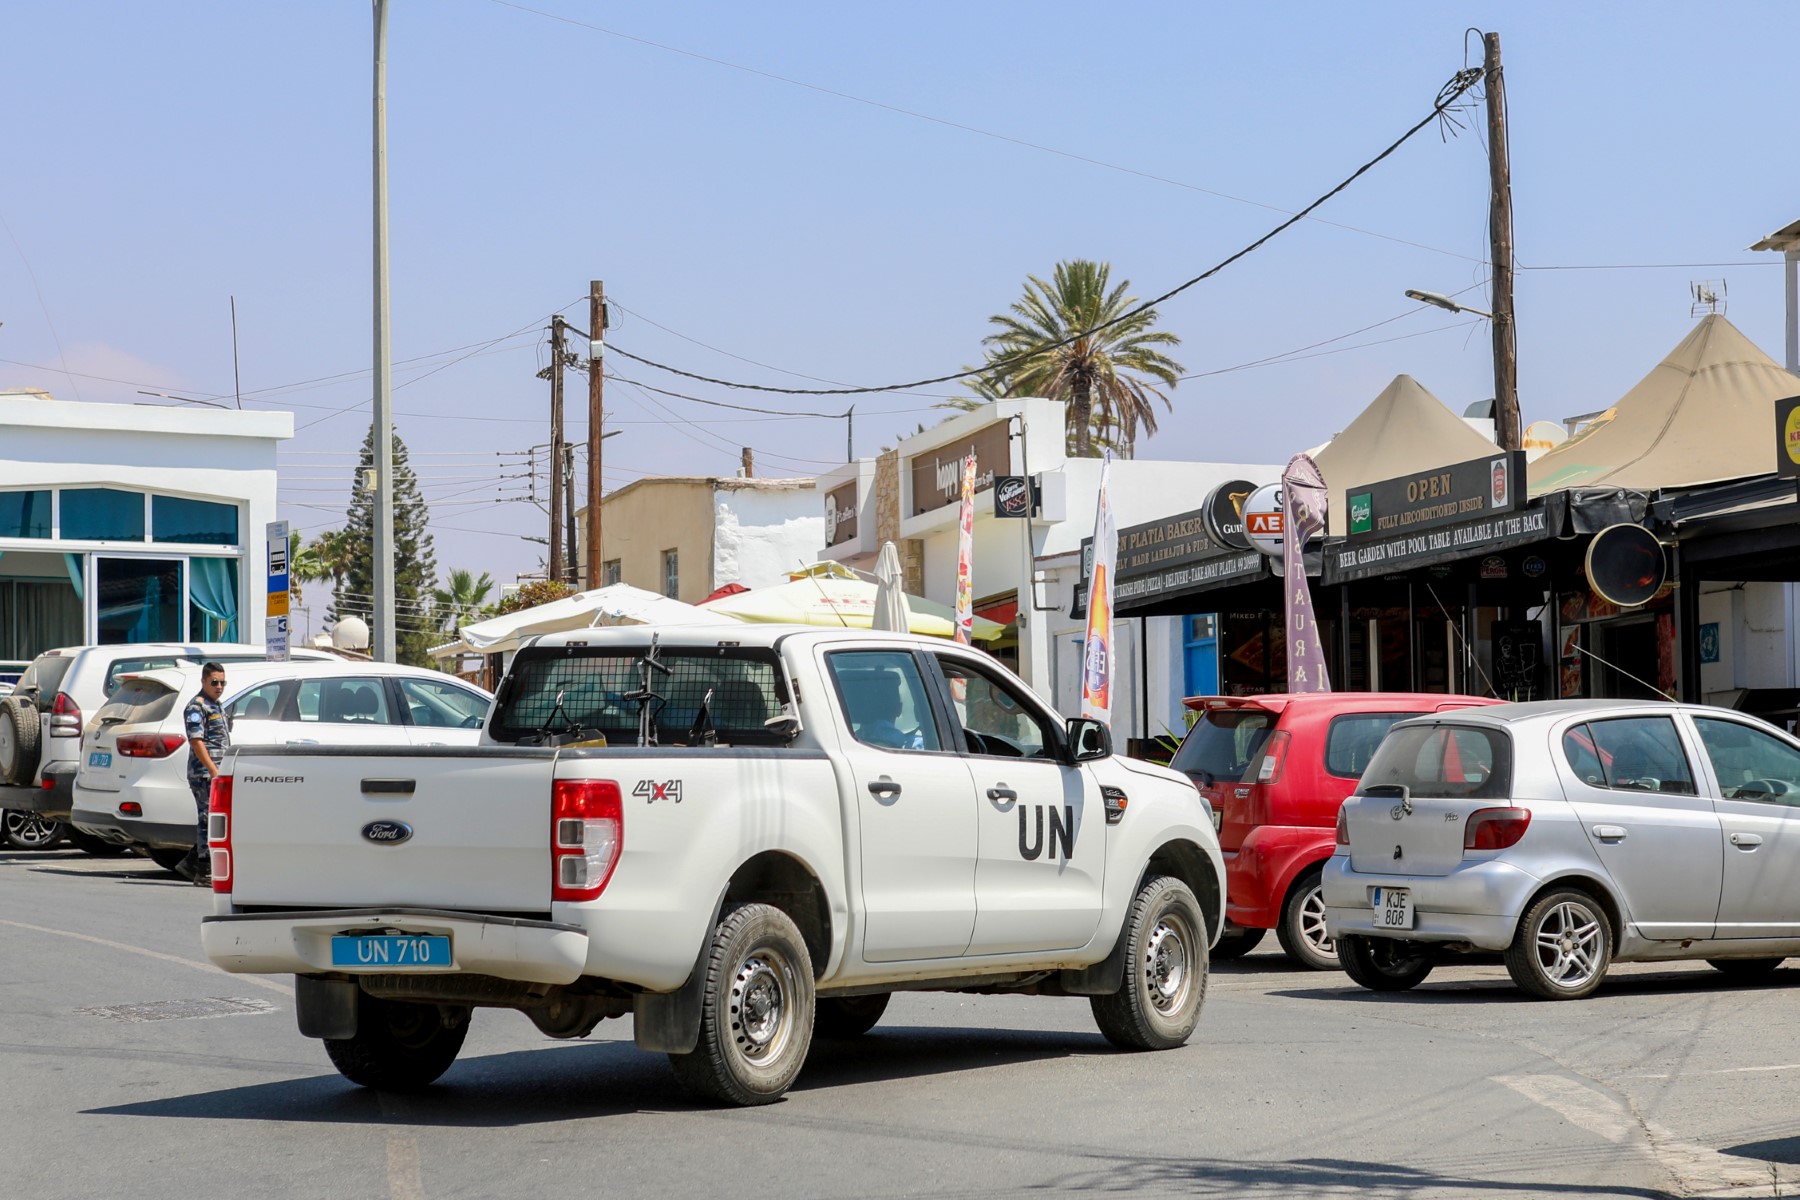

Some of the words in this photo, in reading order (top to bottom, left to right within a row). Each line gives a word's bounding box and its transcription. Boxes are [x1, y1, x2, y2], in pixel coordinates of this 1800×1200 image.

[936, 457, 958, 498] happy
[1407, 474, 1451, 502] OPEN
[1378, 514, 1399, 530] FULLY
[1399, 501, 1458, 526] AIRCONDITIONED
[1459, 495, 1484, 513] INSIDE
[1130, 527, 1165, 549] PLATIA
[1167, 517, 1204, 541] BAKER
[1339, 551, 1358, 569] BEER
[1358, 544, 1386, 565] GARDEN
[1386, 540, 1406, 559] WITH
[1408, 536, 1428, 555] POOL
[1428, 532, 1452, 551] TABLE
[1453, 523, 1493, 546] AVAILABLE
[1493, 520, 1504, 538] AT
[1505, 517, 1521, 536] THE
[1522, 513, 1545, 532] BACK
[1131, 553, 1150, 568] MADE
[1192, 538, 1209, 552] PIDE
[1165, 570, 1189, 588] DELIVERY
[1218, 559, 1237, 576] PLATIA
[632, 780, 682, 804] 4x4
[369, 823, 398, 840] Ford
[1018, 805, 1073, 861] UN
[1386, 892, 1407, 909] KJE
[357, 940, 389, 962] UN
[397, 940, 430, 962] 710
